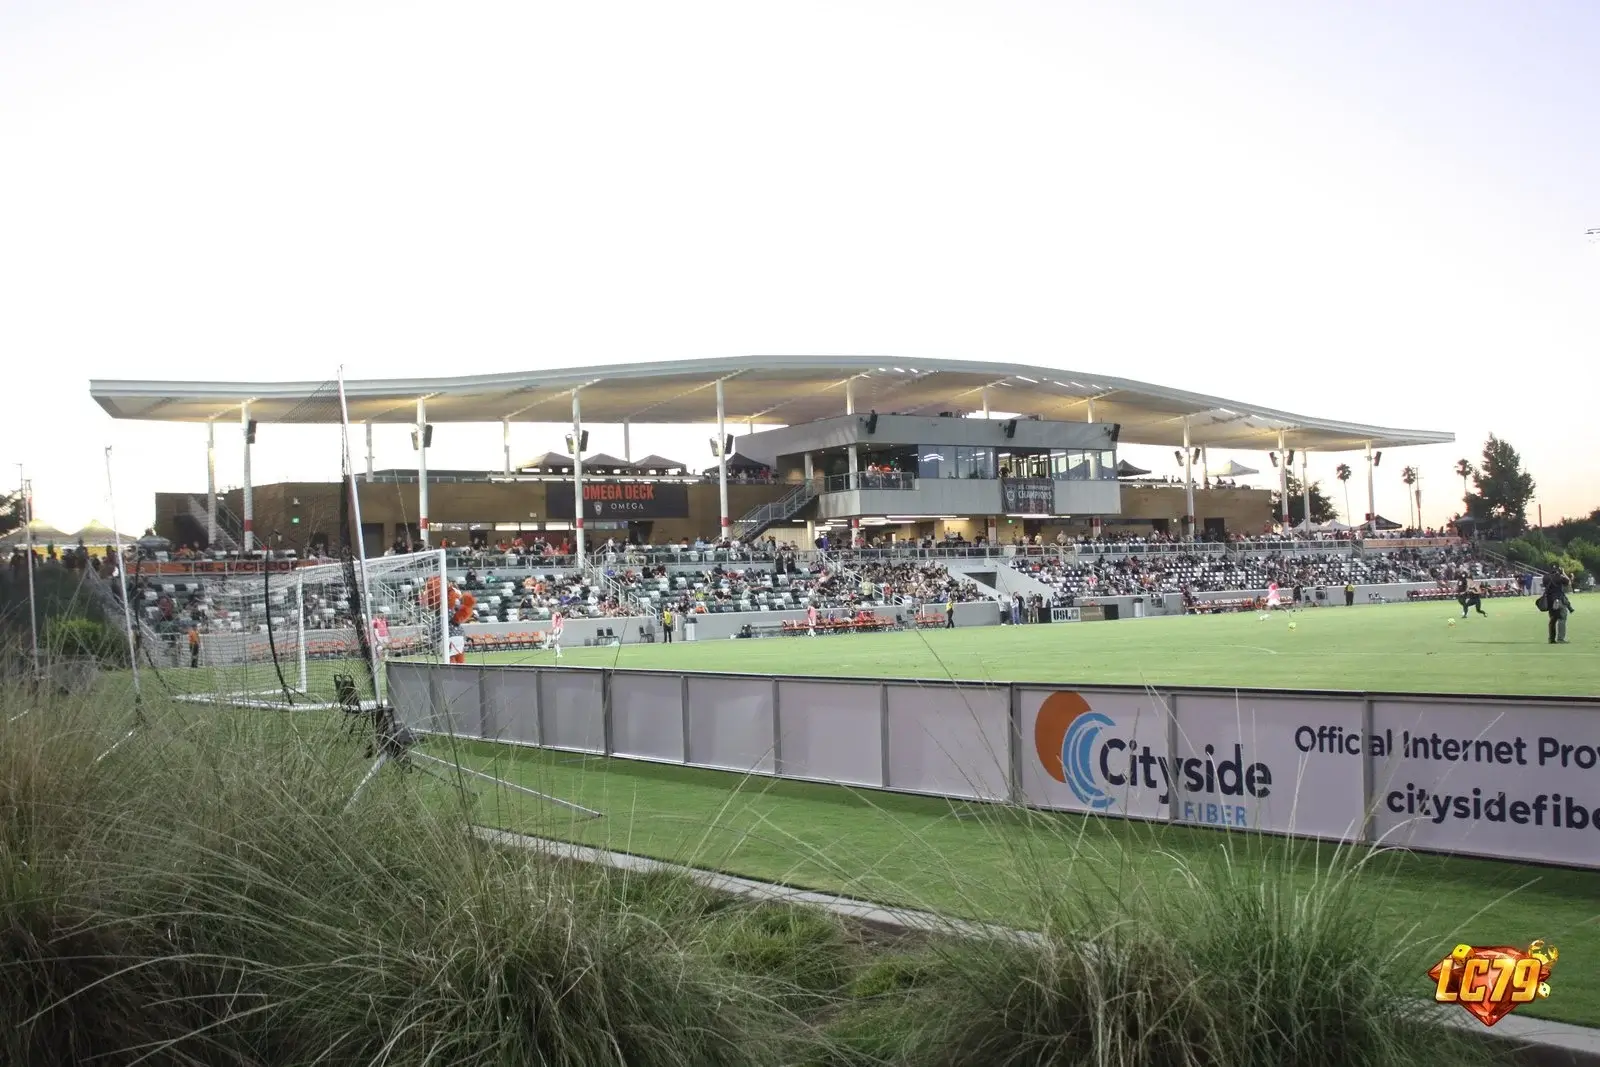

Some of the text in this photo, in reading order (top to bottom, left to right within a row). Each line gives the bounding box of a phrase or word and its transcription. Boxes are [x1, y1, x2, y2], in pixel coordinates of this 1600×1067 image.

[583, 485, 654, 500] OMEGA DECK
[610, 502, 645, 510] OMEGA
[1053, 609, 1071, 620] USL
[1295, 725, 1600, 769] Offical Internet Pro
[1100, 738, 1272, 804] Cityside
[1184, 801, 1248, 826] FIBER
